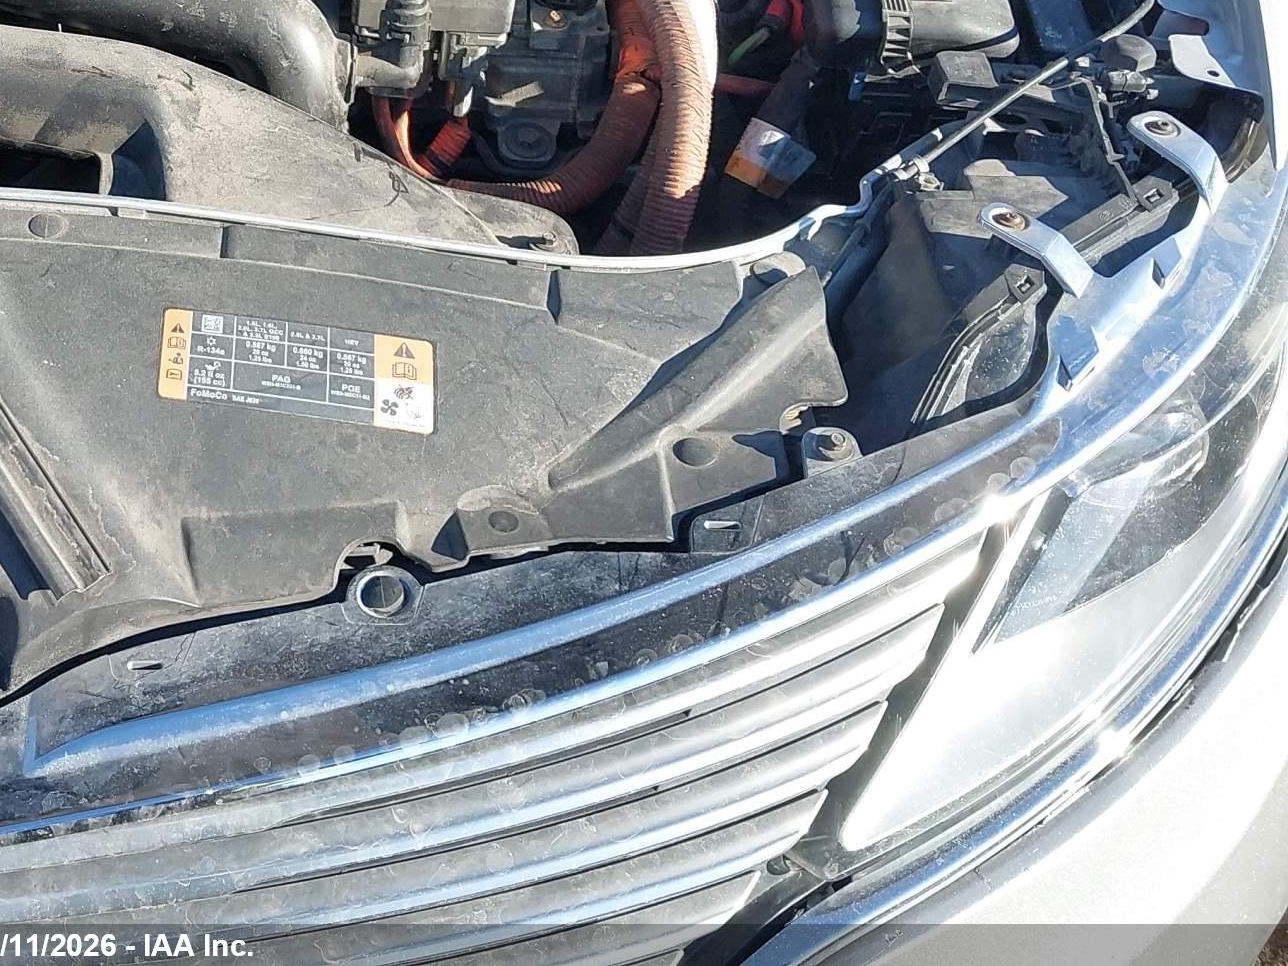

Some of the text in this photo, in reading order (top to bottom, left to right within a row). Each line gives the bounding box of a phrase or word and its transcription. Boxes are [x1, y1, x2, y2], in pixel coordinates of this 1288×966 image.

[197, 346, 226, 356] R-134a
[266, 342, 276, 353] kg
[190, 388, 228, 400] FoMoCo
